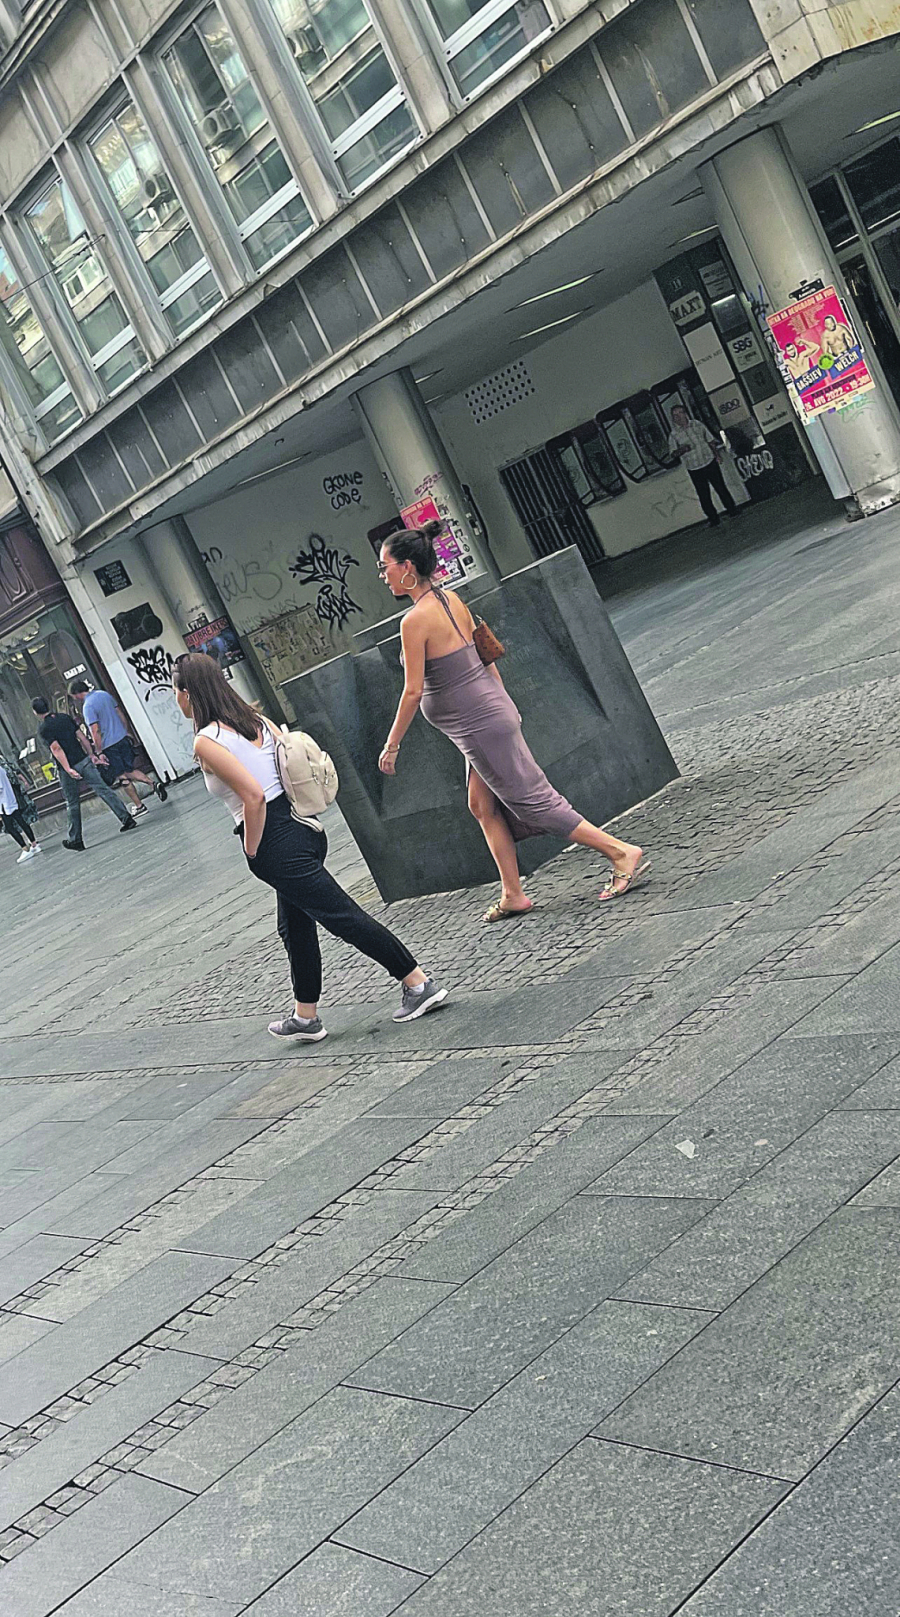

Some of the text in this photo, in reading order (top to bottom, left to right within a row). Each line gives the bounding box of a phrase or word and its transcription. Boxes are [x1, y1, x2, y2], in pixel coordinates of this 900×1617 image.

[732, 337, 753, 354] SBG
[833, 350, 859, 372] WELCH
[813, 396, 827, 408] AVG
